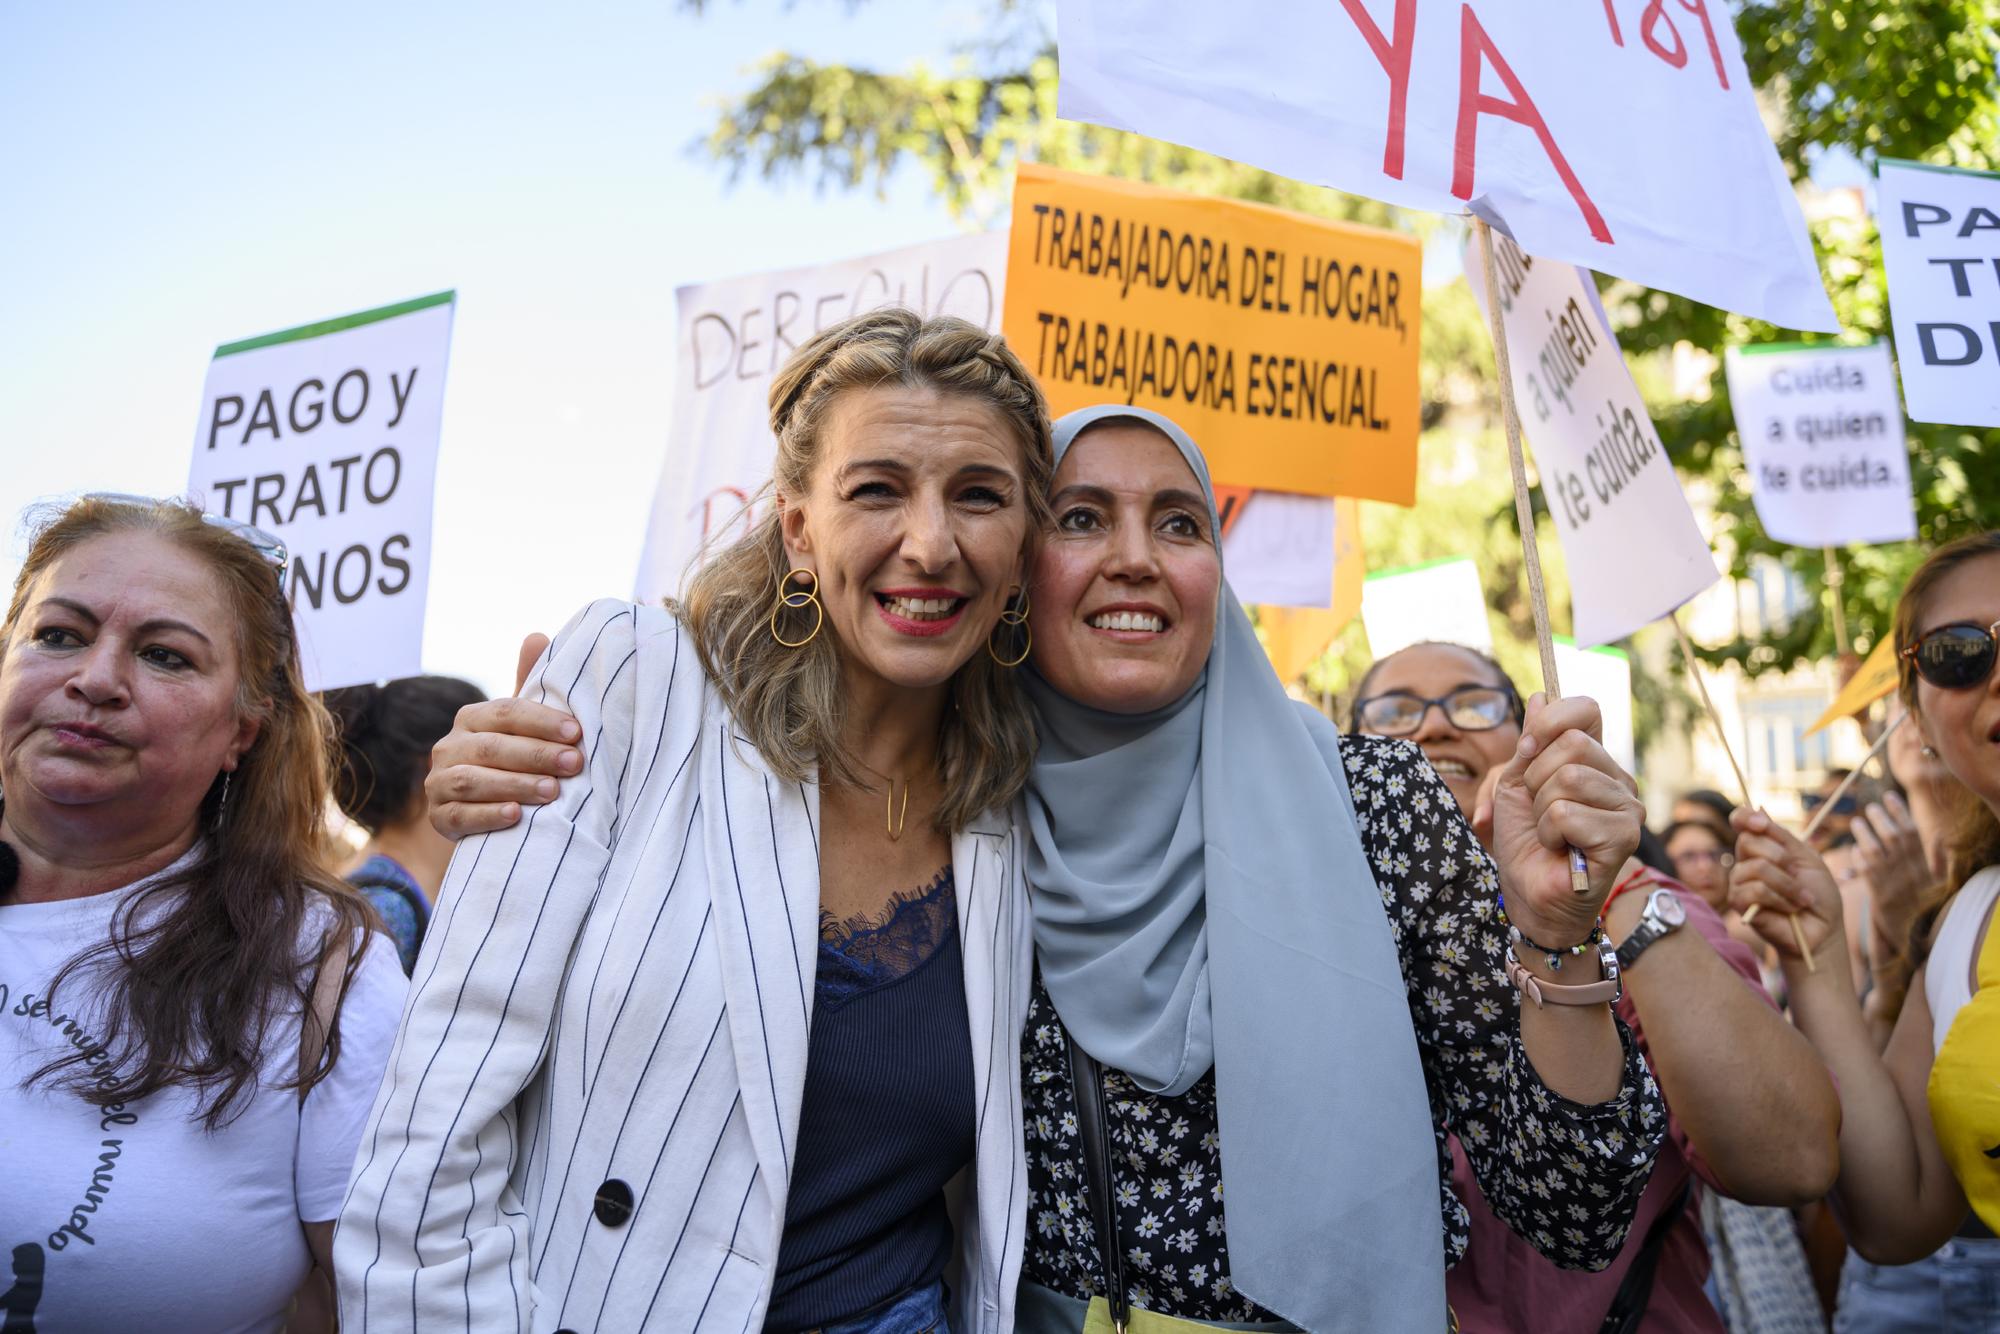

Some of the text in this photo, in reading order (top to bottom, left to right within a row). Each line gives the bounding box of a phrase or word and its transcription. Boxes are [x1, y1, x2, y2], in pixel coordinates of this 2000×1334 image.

[1339, 0, 1615, 244] YA
[1033, 204, 1230, 304] TRABAJADORA
[1240, 247, 1290, 313] DEL
[1300, 255, 1407, 344] HOGAR,
[1037, 312, 1390, 431] TRABAJADORA ESENCIAL.
[1538, 297, 1597, 415] quien
[1770, 363, 1866, 393] Cuida
[207, 366, 419, 450] PAGO y
[1767, 408, 1887, 445] a quien
[212, 446, 402, 527] TRATO
[1553, 468, 1591, 530] te
[1761, 461, 1788, 490] te
[291, 533, 411, 610] NOS
[13, 993, 48, 1018] se
[100, 1102, 138, 1132] el
[48, 1139, 123, 1252] mundo
